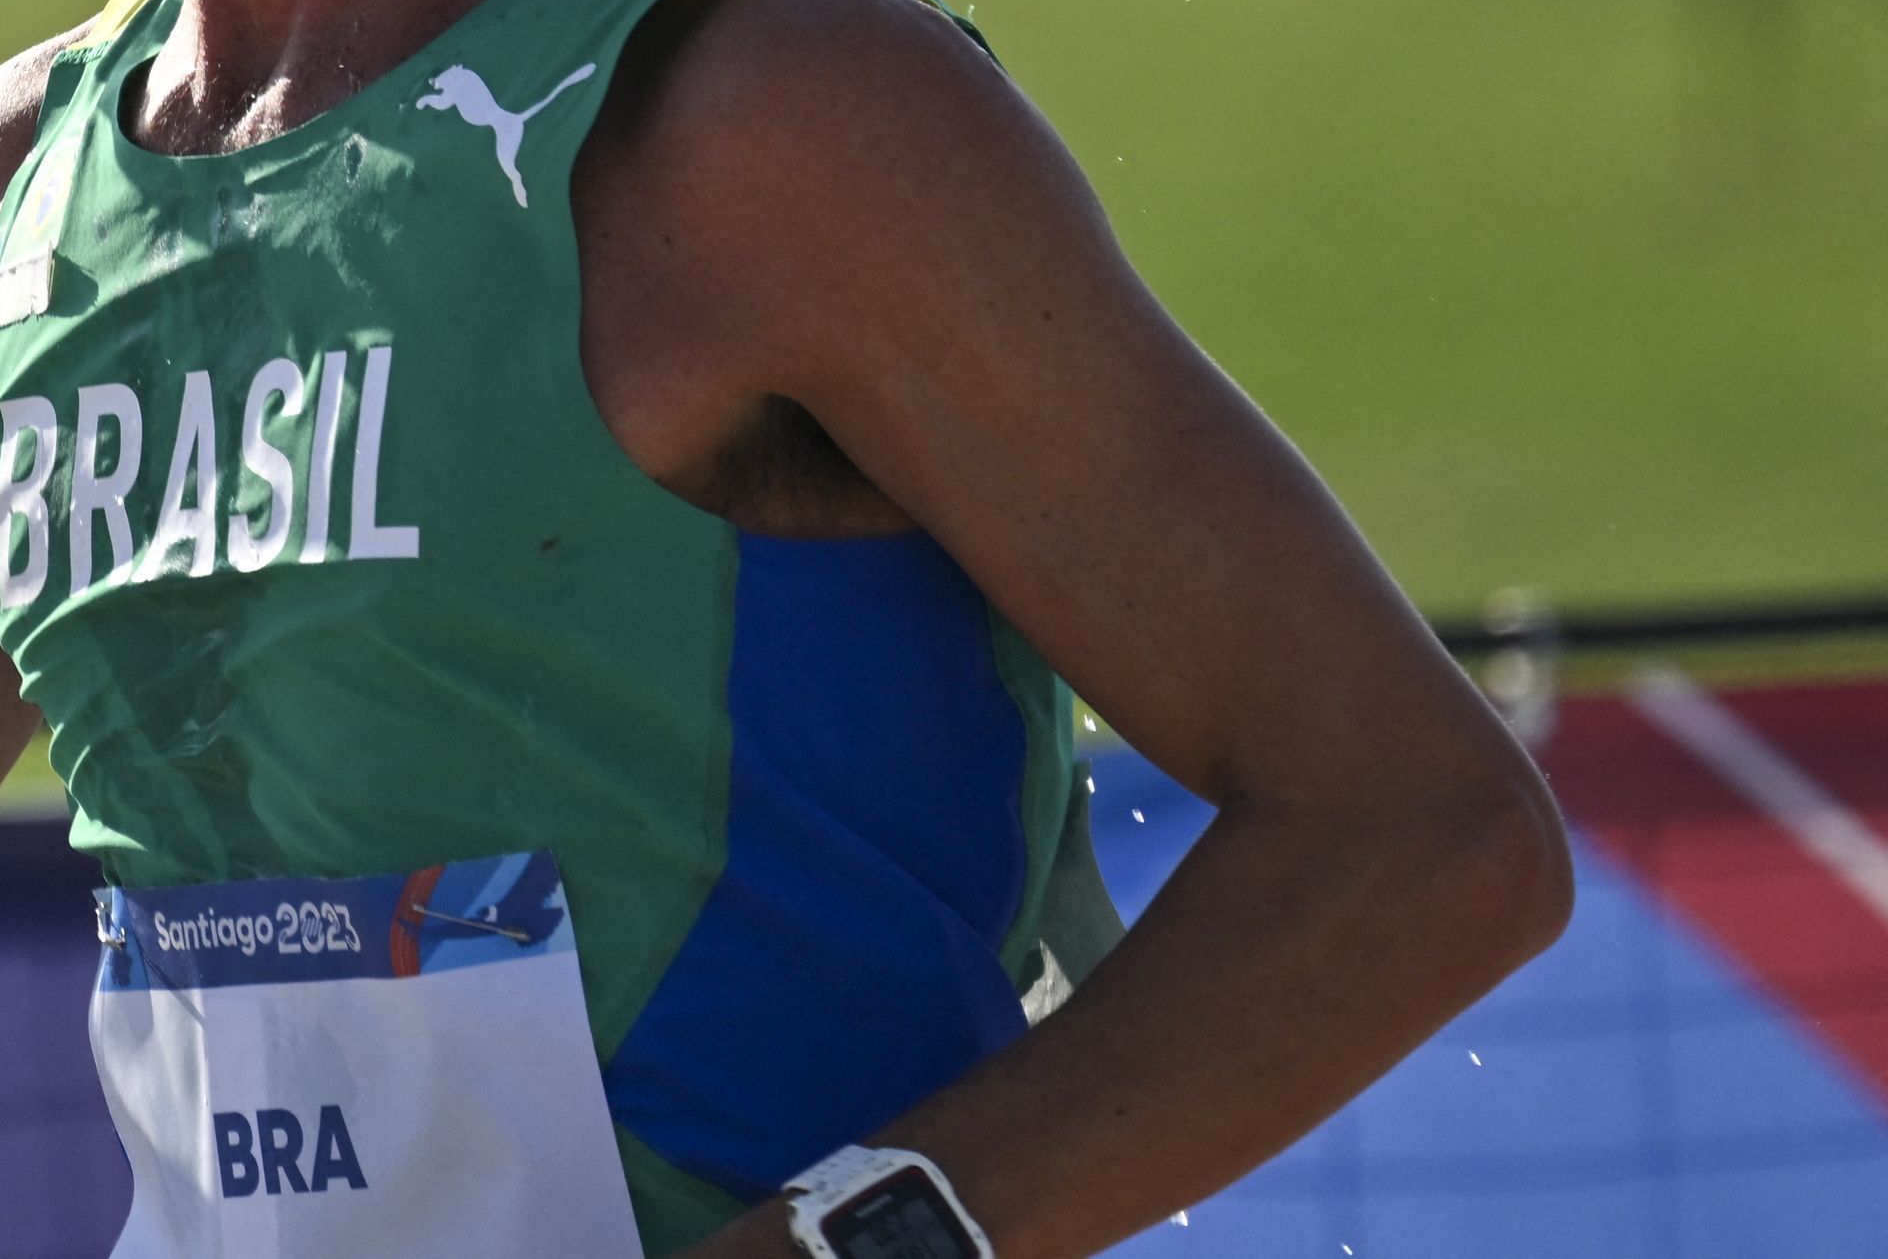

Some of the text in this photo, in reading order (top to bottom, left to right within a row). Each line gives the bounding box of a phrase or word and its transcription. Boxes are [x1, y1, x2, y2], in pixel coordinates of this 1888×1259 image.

[154, 901, 361, 957] Santiago 2023
[213, 1104, 369, 1199] BRA
